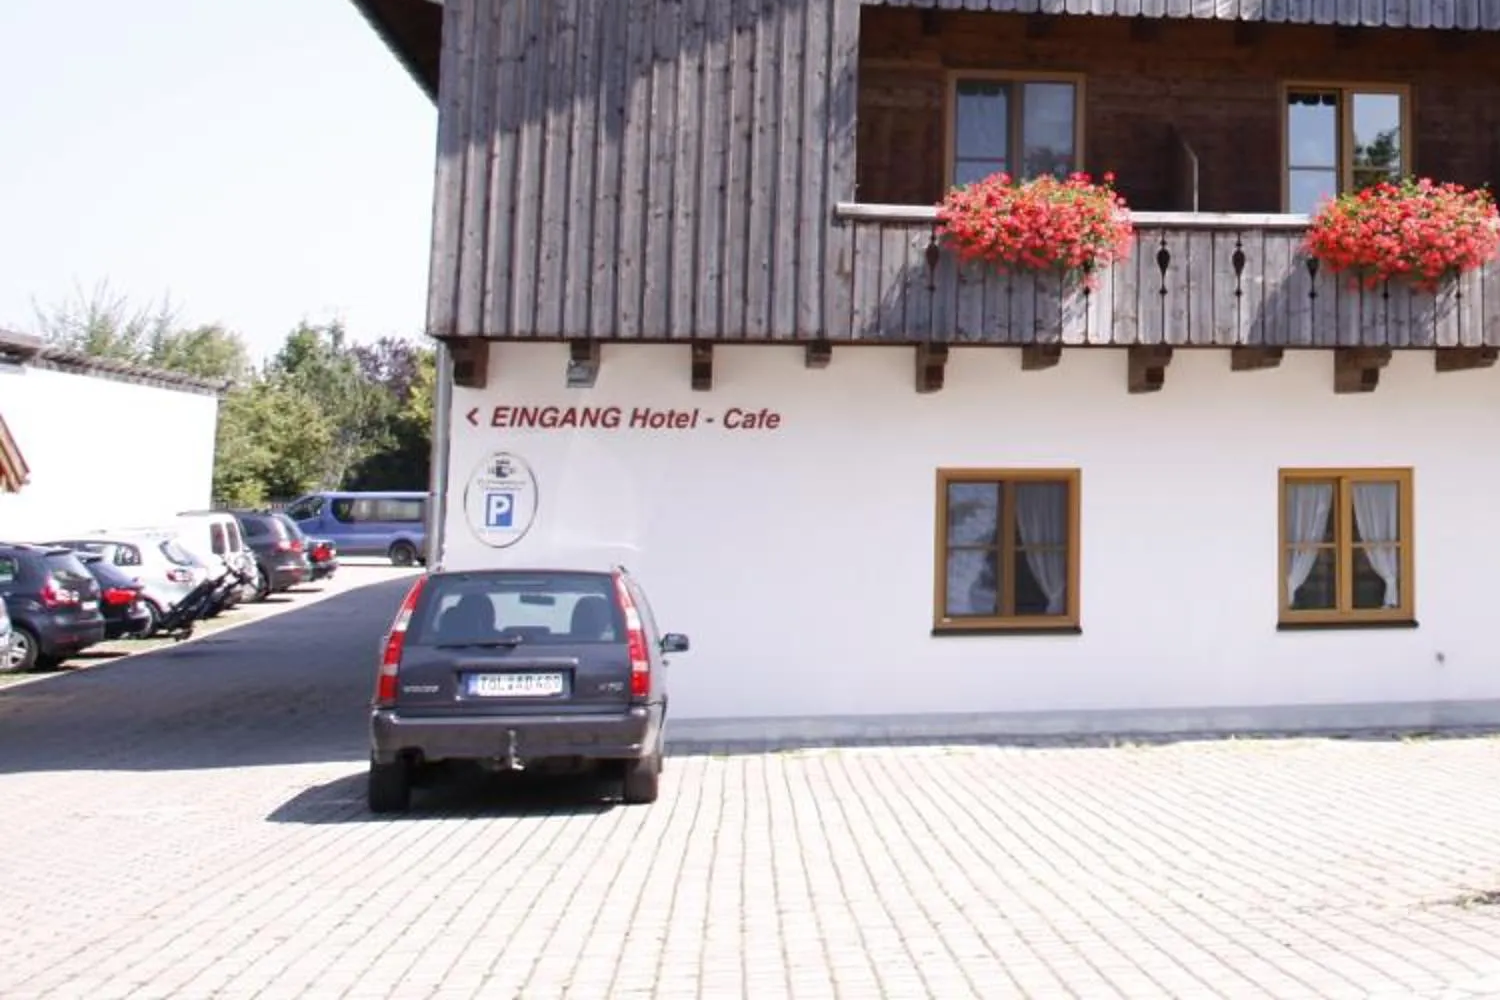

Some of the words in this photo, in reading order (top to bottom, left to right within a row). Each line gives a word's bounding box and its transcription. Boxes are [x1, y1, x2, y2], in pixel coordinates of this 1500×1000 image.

[490, 406, 621, 428] EINGANG
[628, 407, 698, 429] Hotel
[722, 407, 781, 429] Cafe
[489, 495, 510, 526] P
